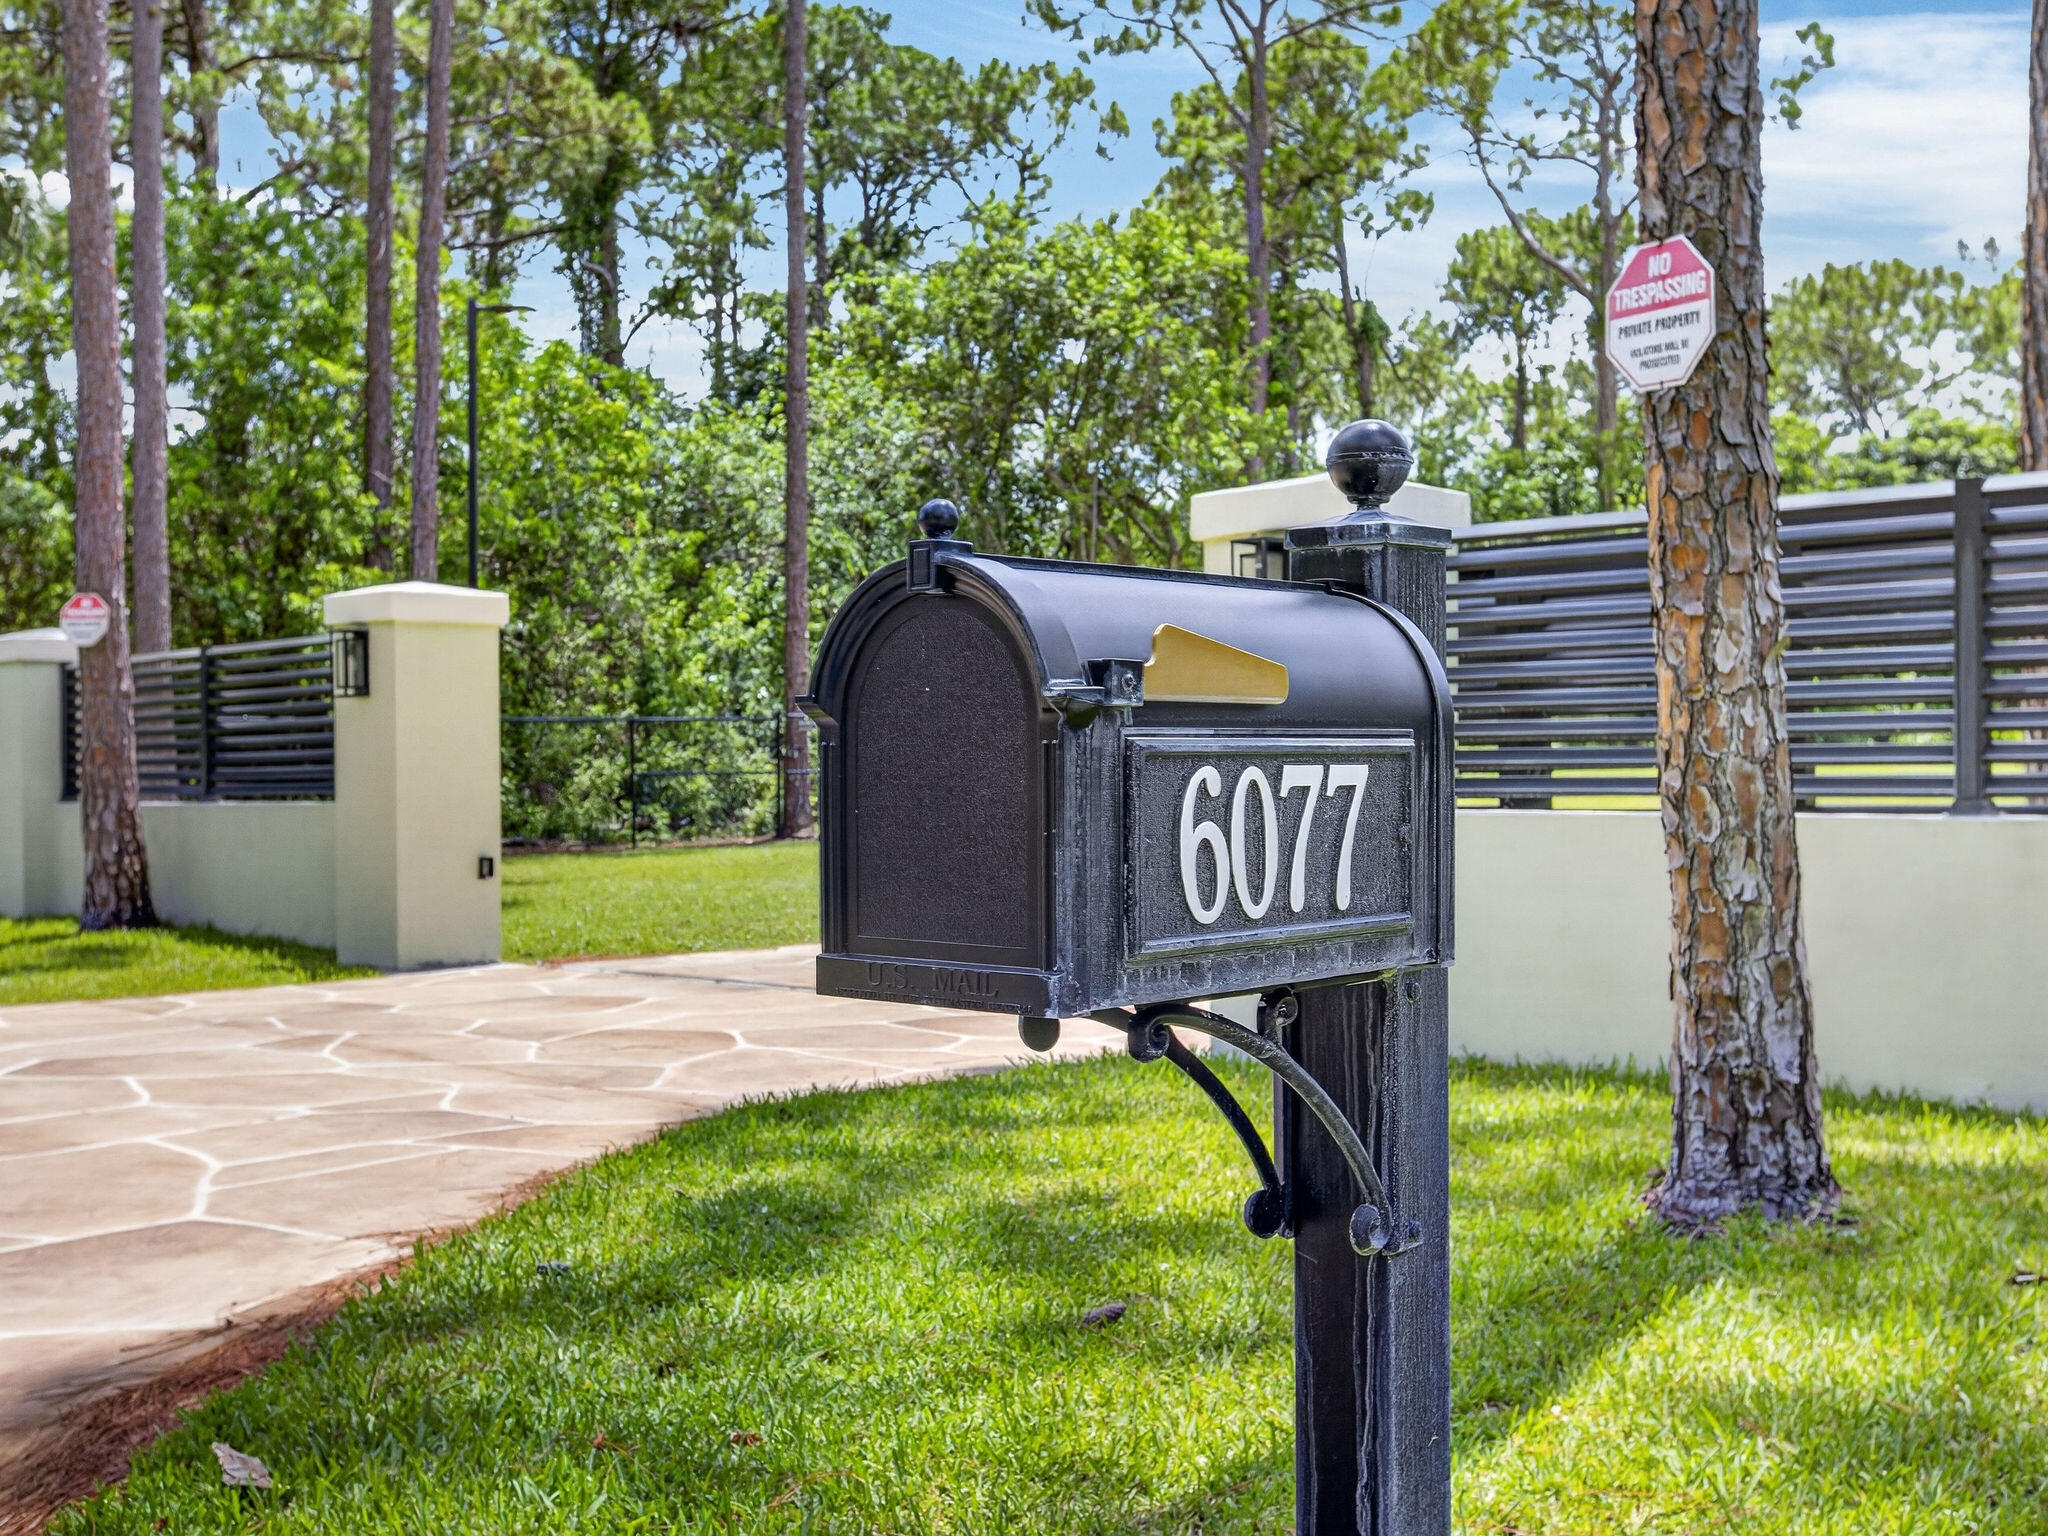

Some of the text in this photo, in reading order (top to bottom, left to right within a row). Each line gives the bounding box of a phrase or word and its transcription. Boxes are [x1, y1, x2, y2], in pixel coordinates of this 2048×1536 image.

[1648, 252, 1672, 278] NO
[1614, 270, 1706, 311] TRESPASSING
[1618, 311, 1700, 339] PRIVATE PROPERTY
[1180, 764, 1369, 925] 6077
[932, 967, 1000, 997] MAIL
